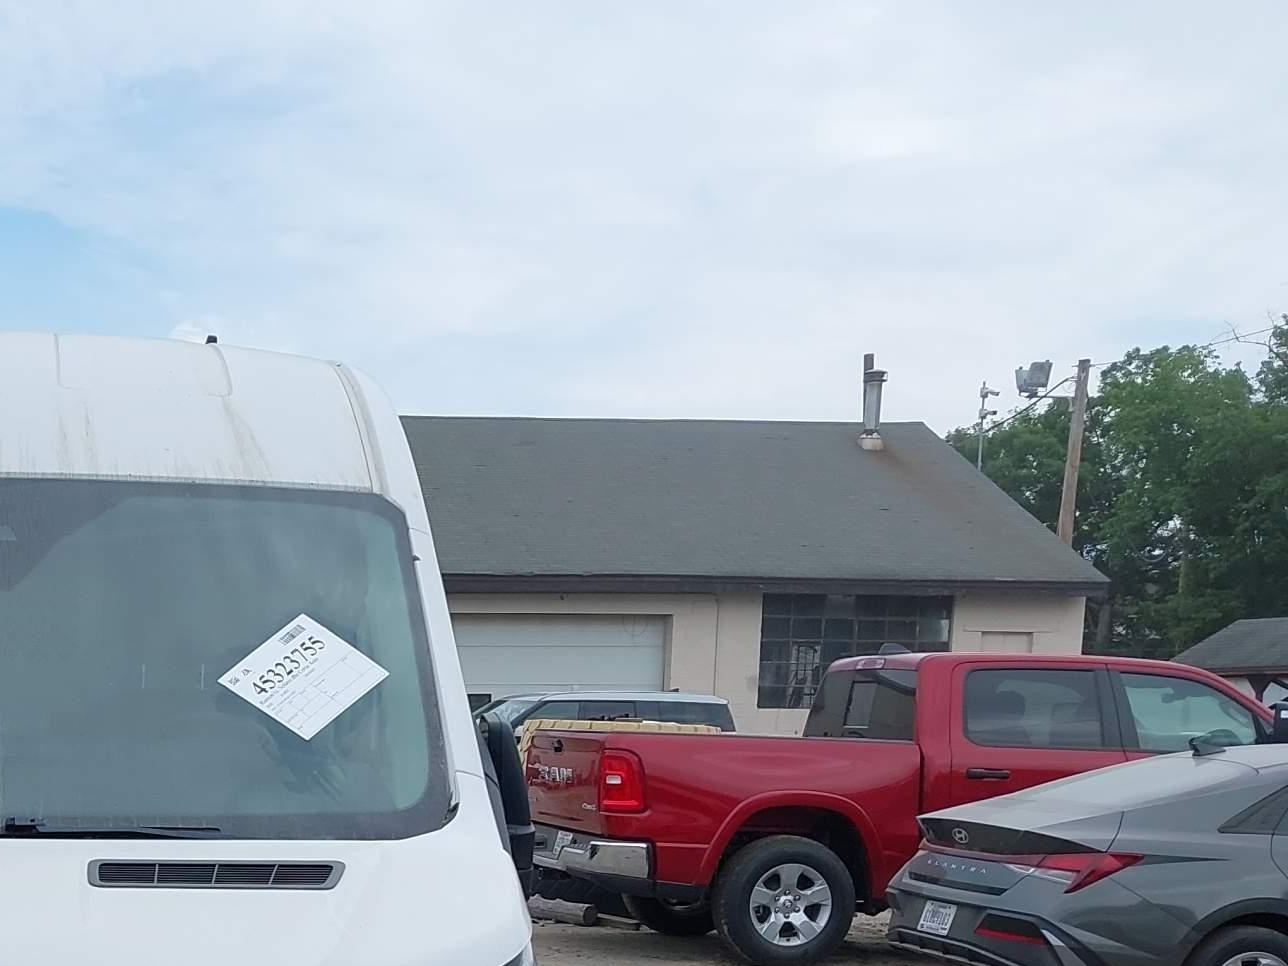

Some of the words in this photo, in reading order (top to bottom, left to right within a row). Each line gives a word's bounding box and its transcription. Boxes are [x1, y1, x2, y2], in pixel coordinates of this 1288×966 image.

[252, 635, 326, 695] 45323755
[538, 765, 573, 785] RAM
[927, 859, 987, 874] ELANTRA
